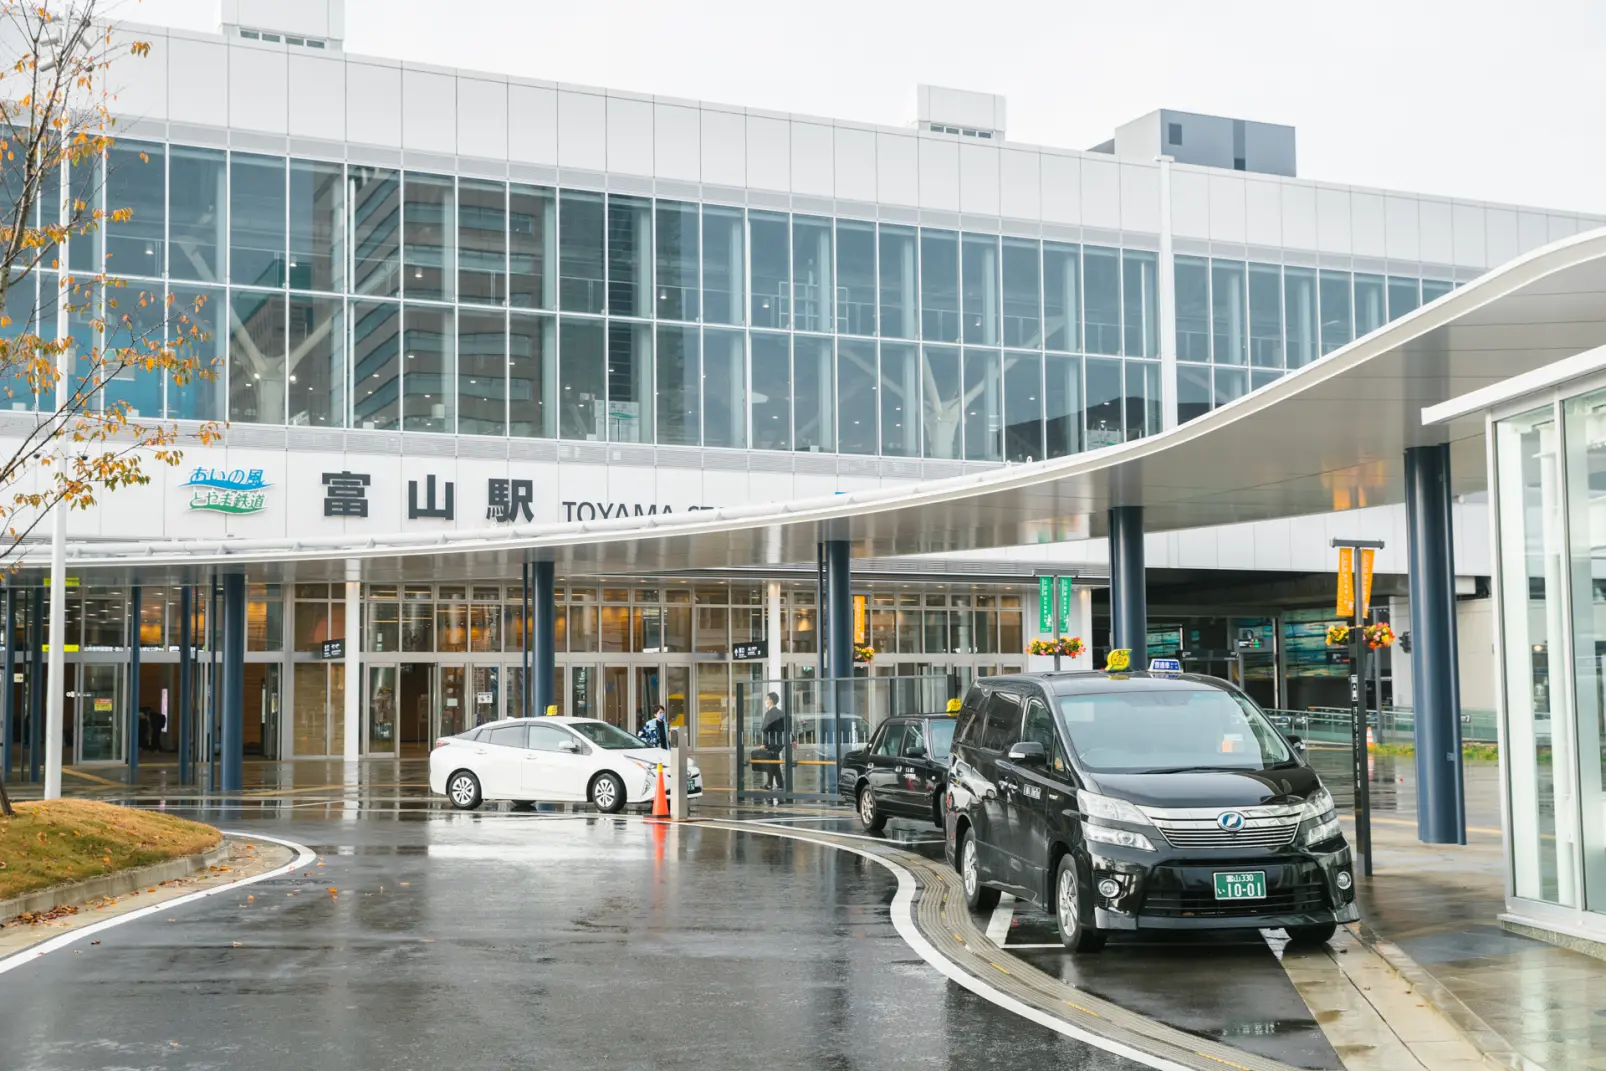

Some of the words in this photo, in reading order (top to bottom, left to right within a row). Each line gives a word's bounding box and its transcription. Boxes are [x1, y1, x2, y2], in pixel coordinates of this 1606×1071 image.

[189, 466, 267, 487] あいの風
[189, 491, 266, 508] とやま鉄道
[322, 471, 535, 523] 富山駅
[1228, 882, 1261, 897] 10-01
